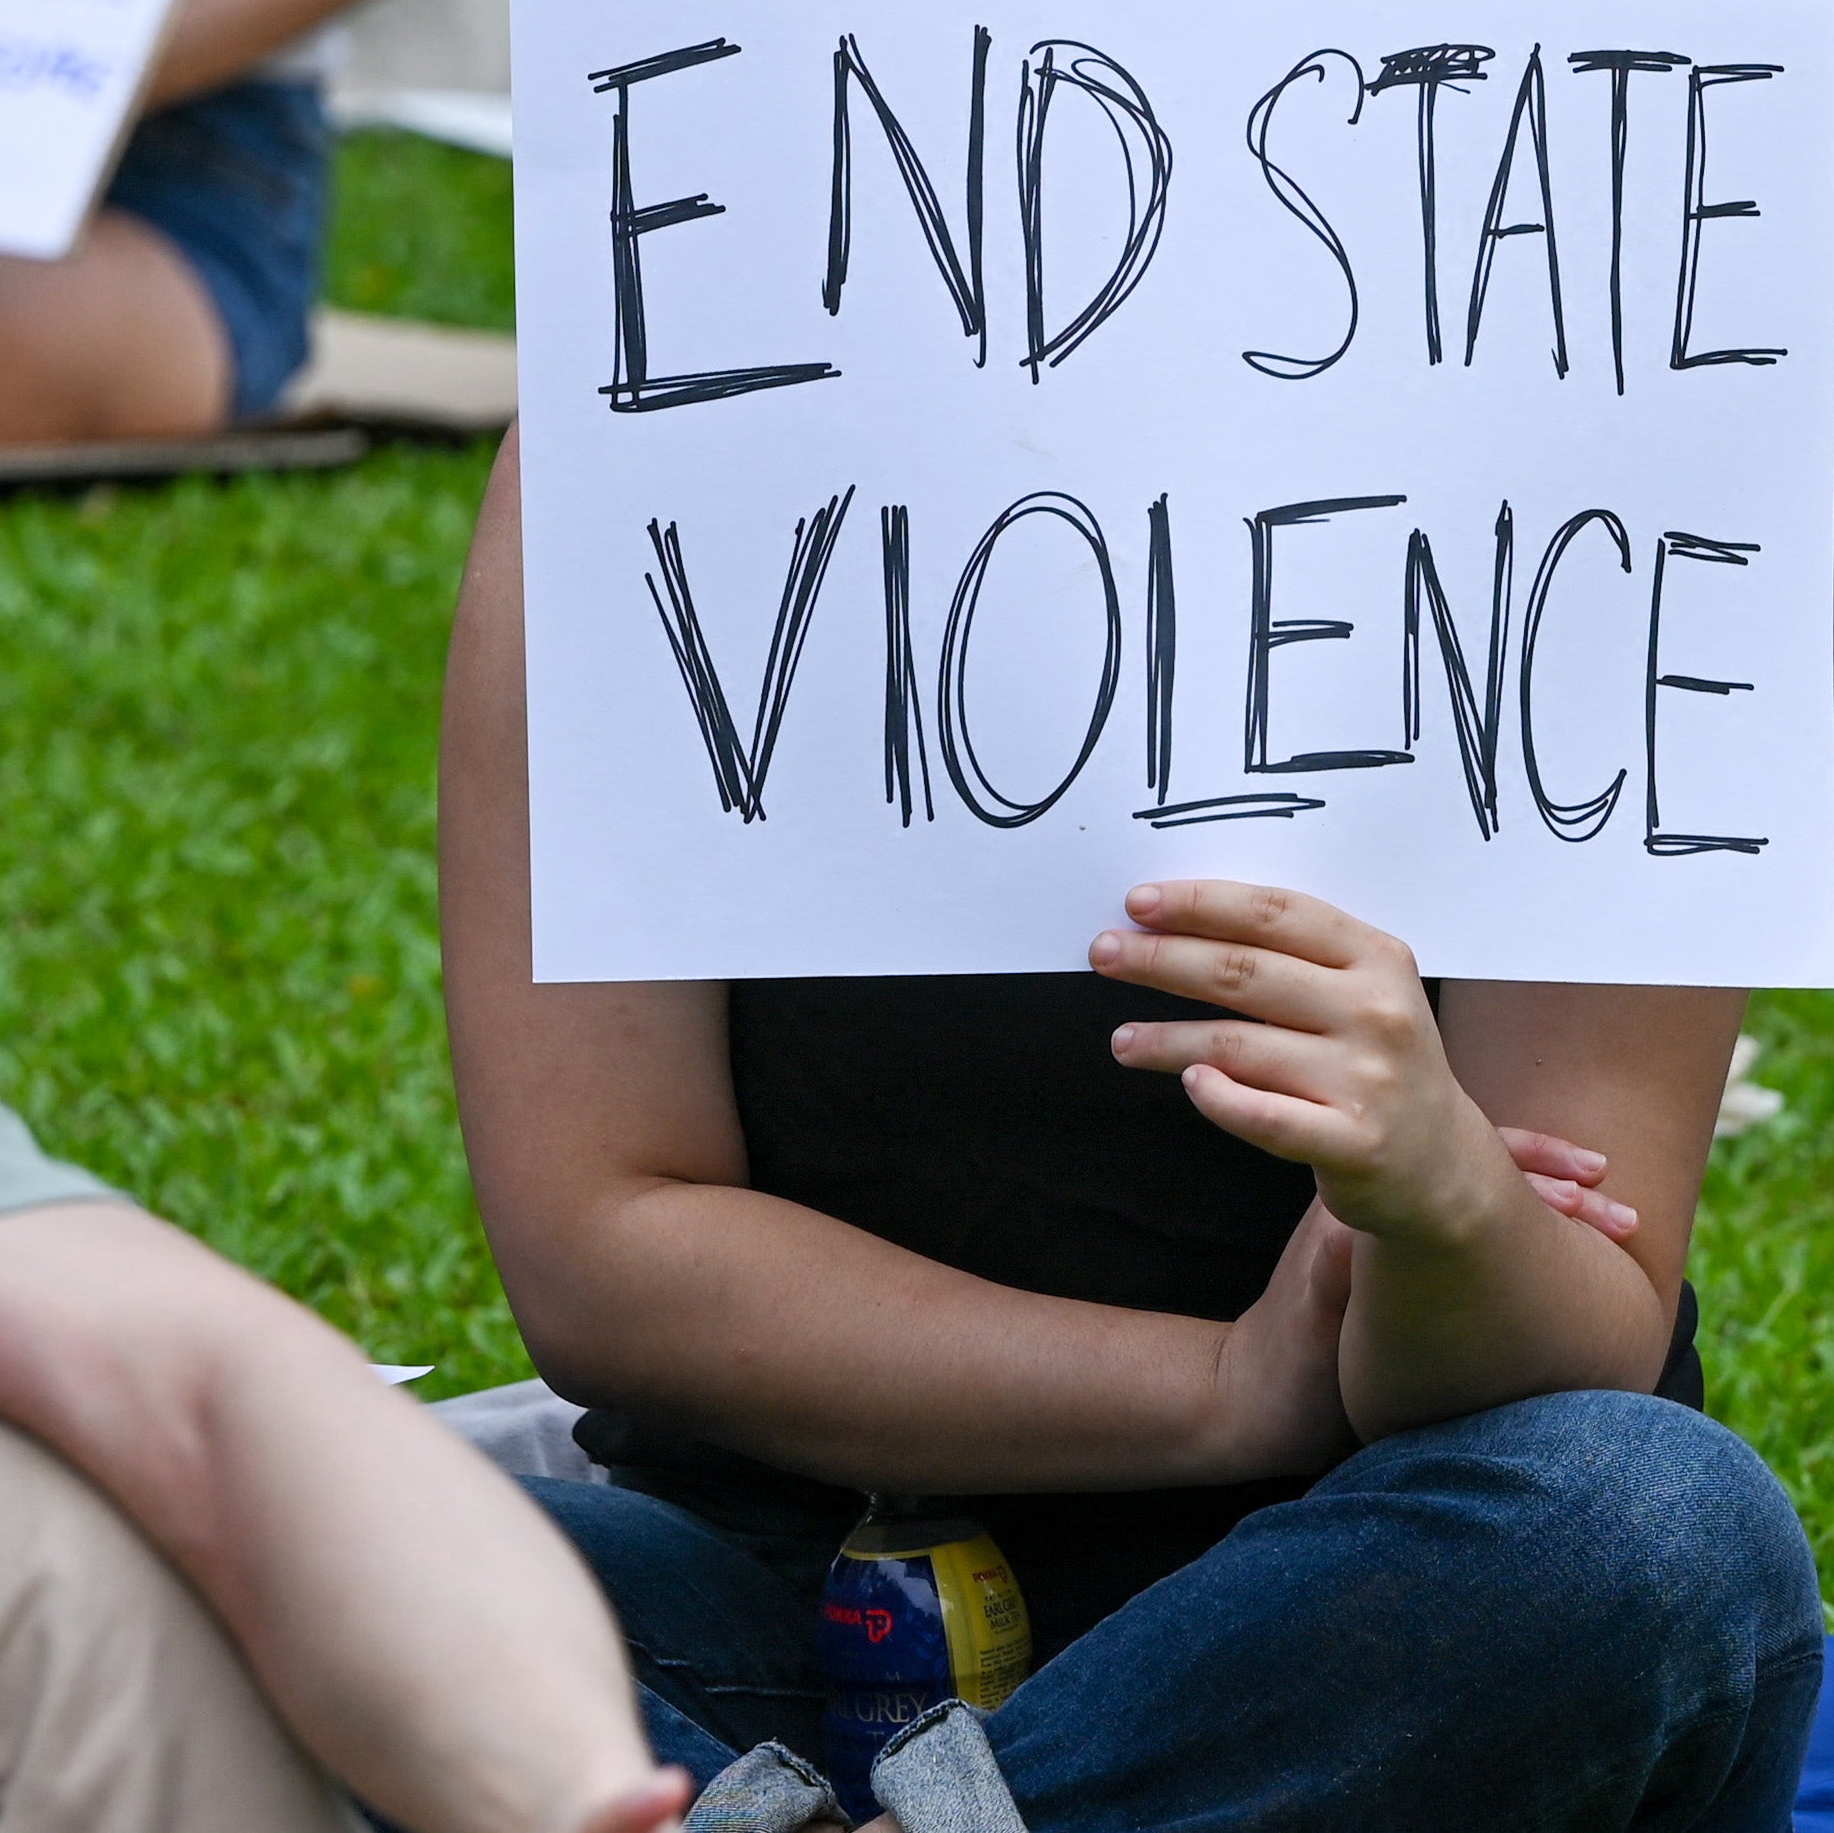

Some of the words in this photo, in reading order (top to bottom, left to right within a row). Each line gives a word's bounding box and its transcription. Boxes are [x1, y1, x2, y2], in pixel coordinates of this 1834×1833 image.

[588, 25, 1172, 413] END
[1242, 43, 1788, 396] STATE
[645, 484, 1769, 856] VIOLENCE
